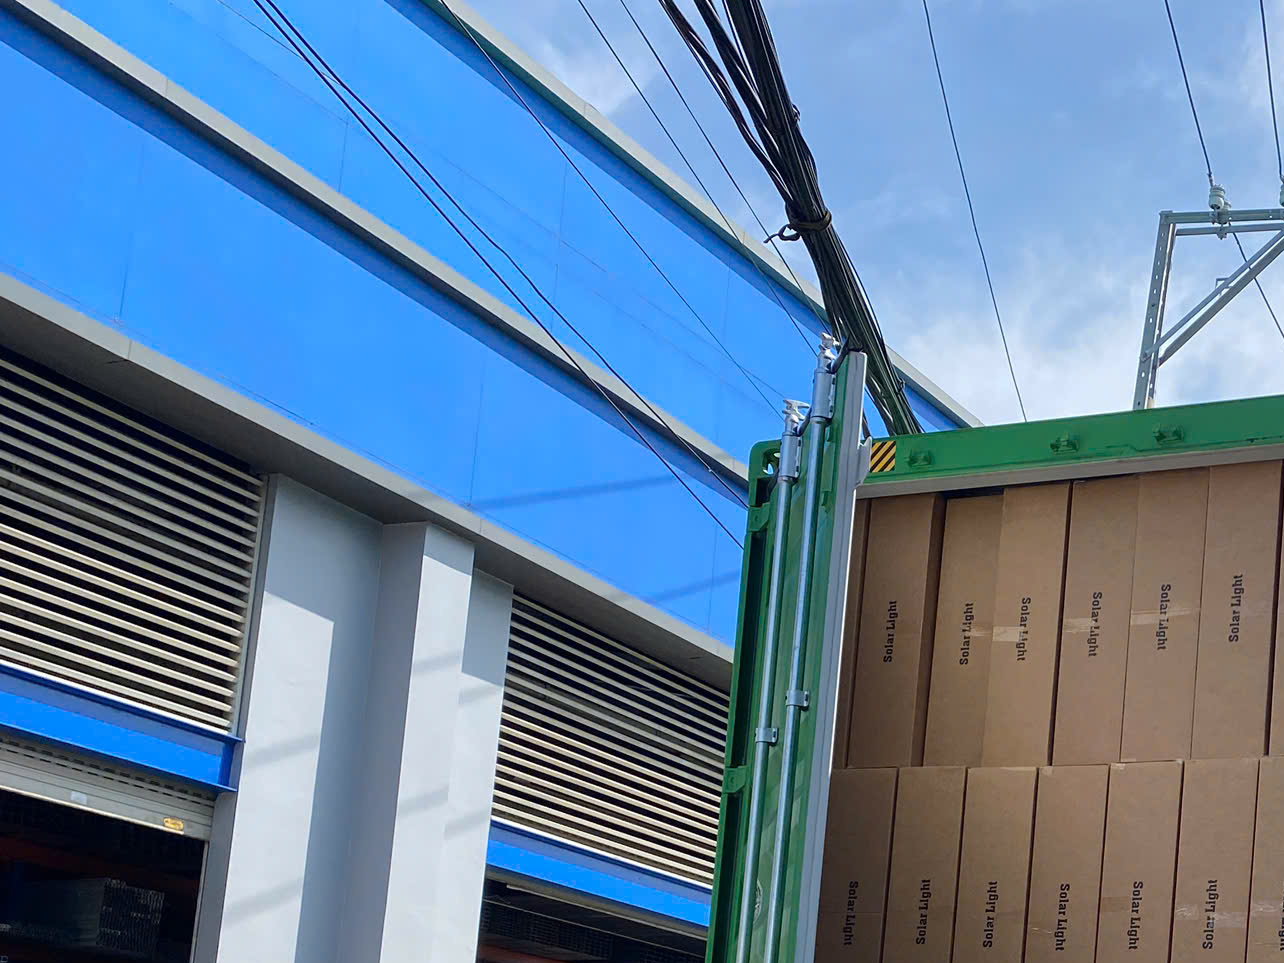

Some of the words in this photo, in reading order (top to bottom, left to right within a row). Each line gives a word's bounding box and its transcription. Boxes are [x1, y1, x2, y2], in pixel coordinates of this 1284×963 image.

[1090, 591, 1103, 623] Solar
[1159, 583, 1172, 616] Solar
[1230, 573, 1245, 608] Light
[885, 600, 899, 631] Light
[961, 602, 975, 633] Light
[1019, 597, 1032, 628] Solar
[1228, 609, 1241, 643] Solar
[882, 632, 895, 663] Solar
[959, 635, 971, 666] Solar
[846, 880, 859, 913] Solar
[918, 879, 932, 911] Light
[985, 880, 999, 913] Light
[1057, 883, 1071, 916] Solar
[1131, 881, 1144, 915] Solar
[1204, 879, 1220, 913] Light
[842, 914, 856, 946] Light
[915, 912, 928, 945] Solar
[982, 915, 995, 948] Solar
[1053, 918, 1068, 951] Light
[1126, 916, 1141, 950] Light
[1201, 915, 1216, 950] Solar
